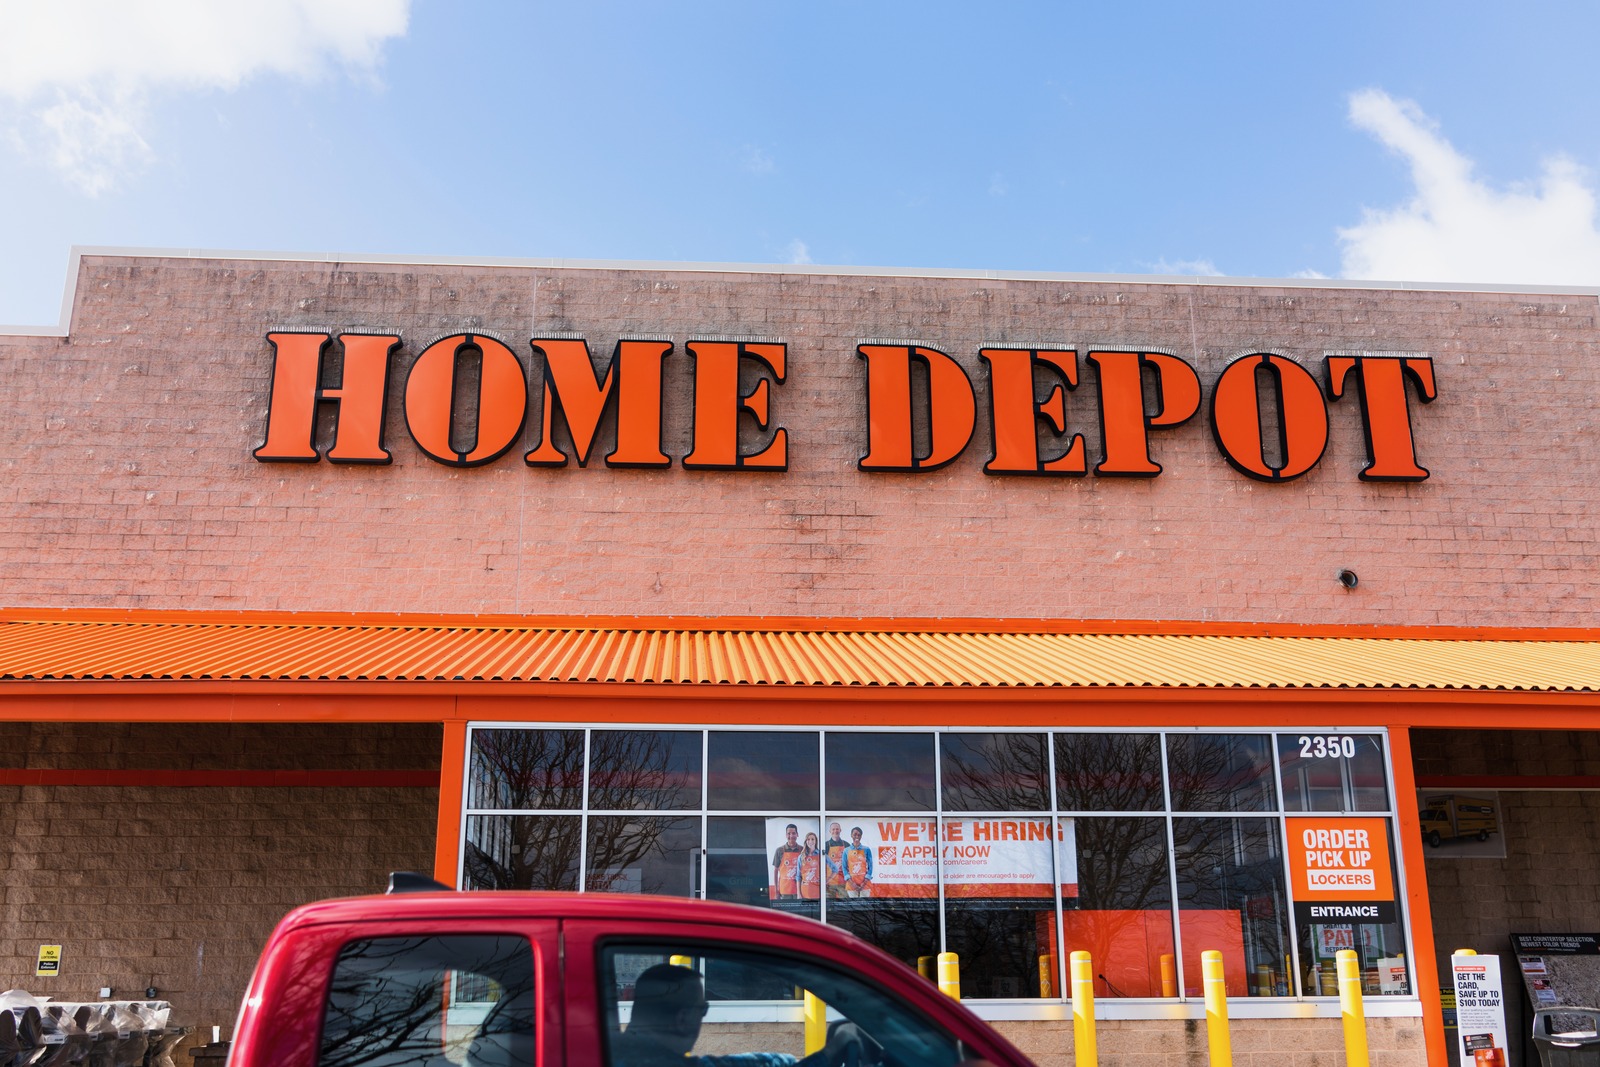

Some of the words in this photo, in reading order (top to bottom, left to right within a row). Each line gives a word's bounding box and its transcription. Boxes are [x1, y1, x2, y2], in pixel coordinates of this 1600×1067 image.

[253, 332, 788, 471] HOME
[855, 343, 1437, 483] DEPOT
[1298, 736, 1356, 758] 2350
[877, 822, 963, 842] WE'RE
[973, 821, 1064, 841] HIRING
[1302, 829, 1370, 849] ORDER
[901, 845, 949, 858] APPLY
[954, 845, 991, 858] NOW
[1305, 850, 1346, 867] PICK
[1349, 850, 1372, 867] UP
[1310, 874, 1372, 885] LOCKERS
[1310, 906, 1379, 917] ENTRANCE
[1457, 973, 1470, 981] GET
[1473, 973, 1485, 981] THE
[1458, 981, 1479, 990] CARD,
[1459, 990, 1477, 998] SAVE
[1478, 990, 1487, 998] UP
[1490, 990, 1499, 998] TO
[1459, 999, 1477, 1007] $100
[1478, 999, 1500, 1007] TODAY
